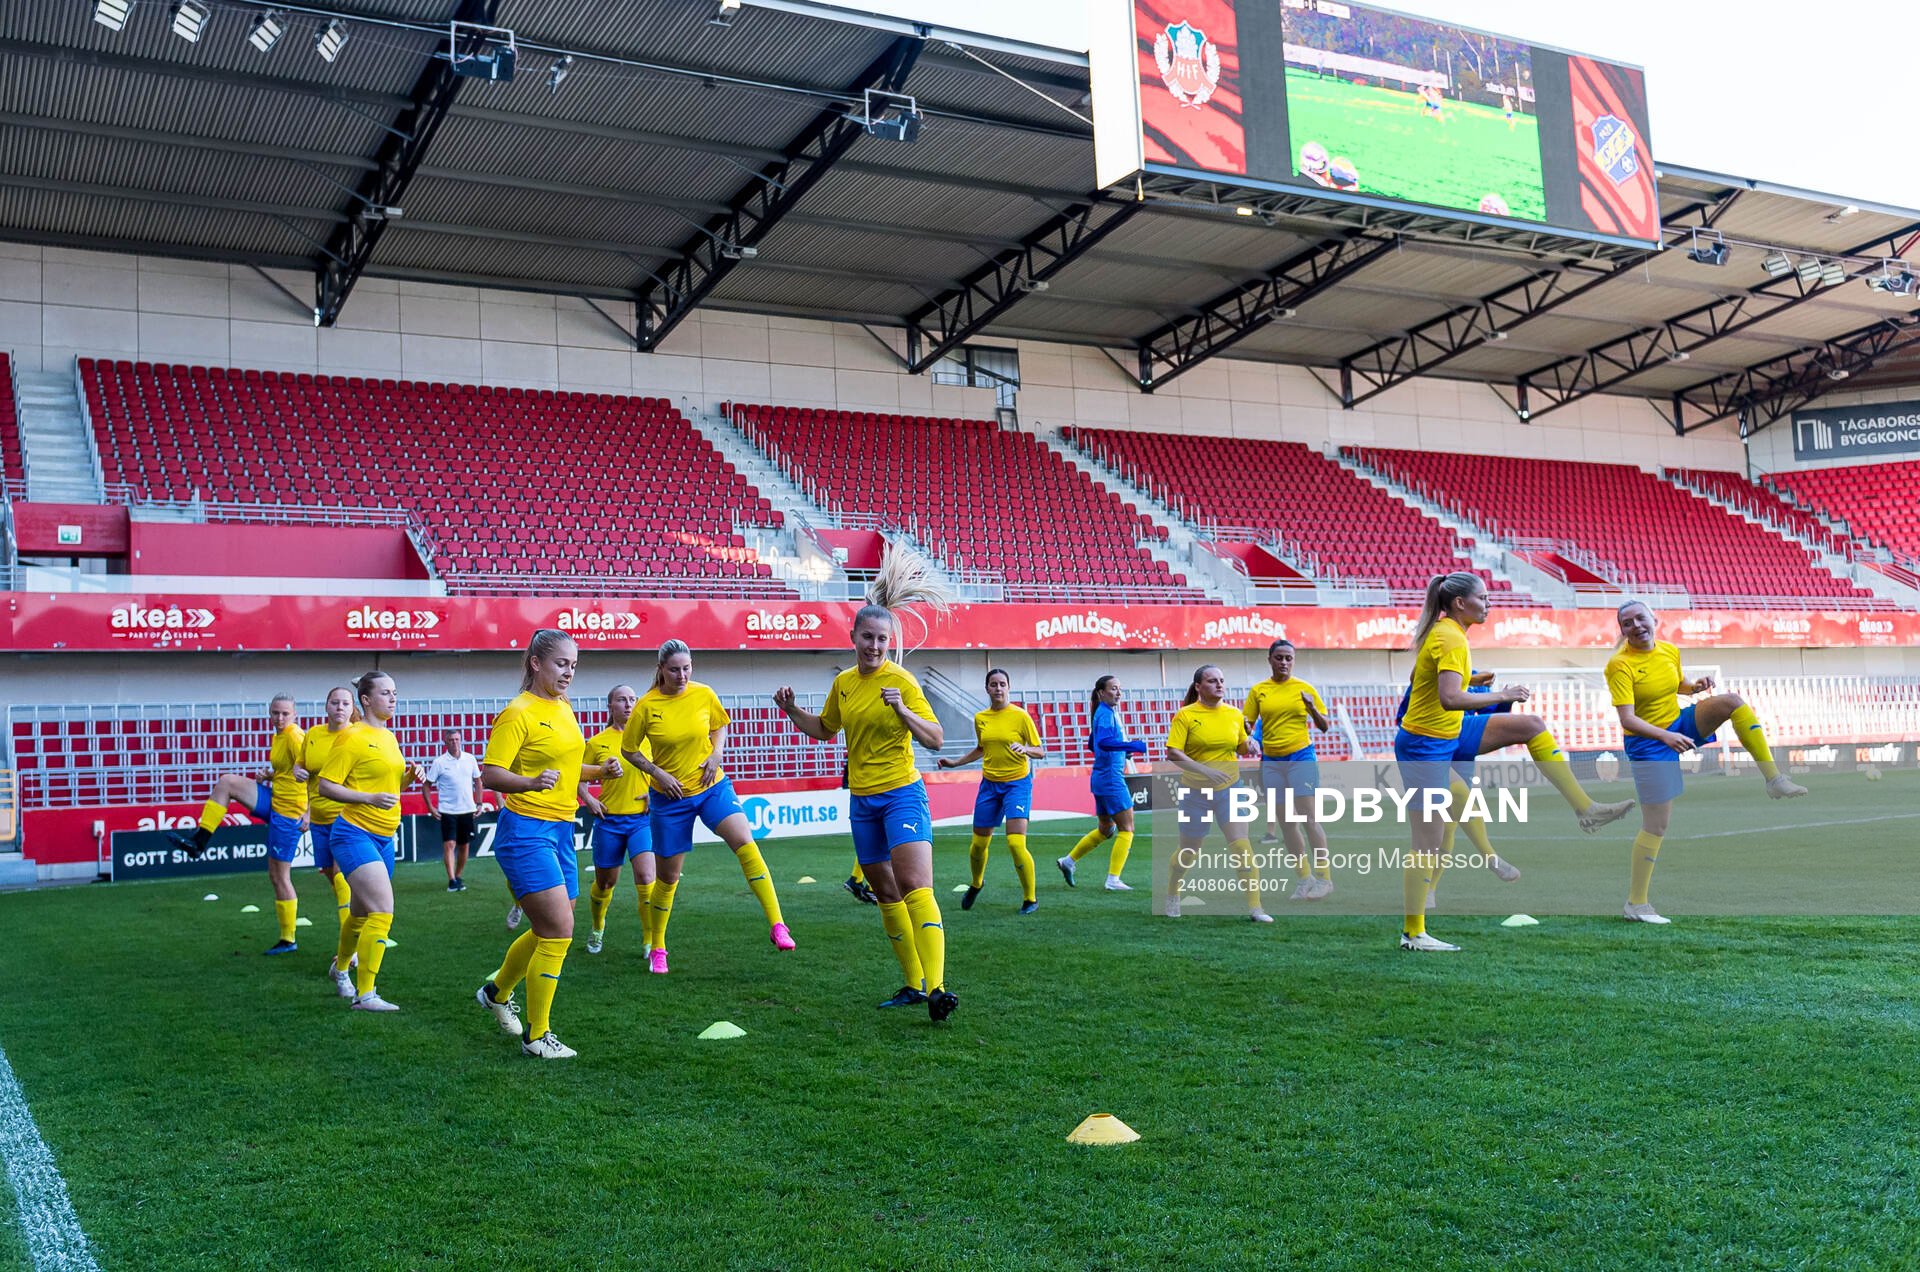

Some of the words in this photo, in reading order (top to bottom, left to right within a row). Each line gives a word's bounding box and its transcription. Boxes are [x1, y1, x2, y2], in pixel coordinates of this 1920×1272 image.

[111, 603, 183, 628] akea
[346, 605, 411, 629] akea
[557, 607, 615, 630] akea
[746, 609, 798, 630] akea
[1035, 611, 1127, 642] RAMLÖSA
[1204, 612, 1287, 641] RAMLÖSA
[1356, 613, 1418, 641] RAMLÖS
[137, 810, 202, 832] ake
[778, 805, 838, 826] Flytt.se
[123, 850, 168, 867] GOTT
[232, 843, 268, 860] MED
